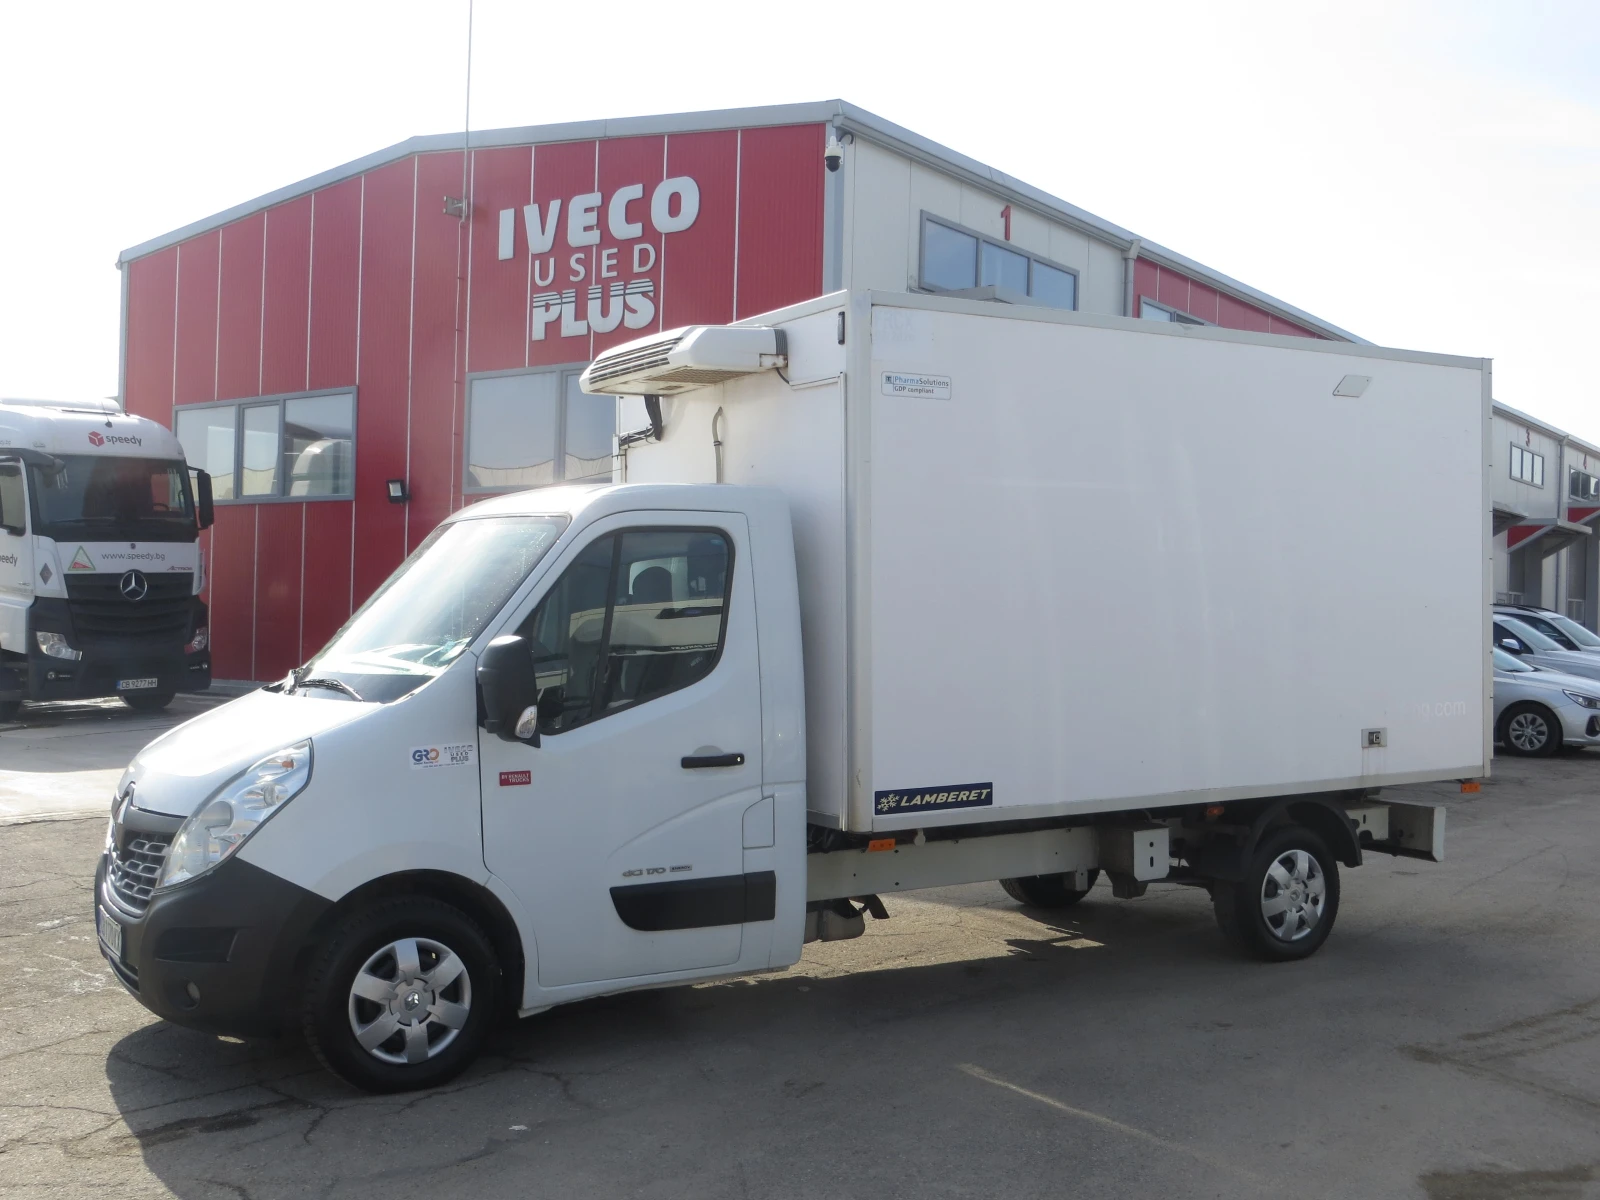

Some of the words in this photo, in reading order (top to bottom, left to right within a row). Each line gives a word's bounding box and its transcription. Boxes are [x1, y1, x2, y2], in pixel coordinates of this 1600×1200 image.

[498, 176, 700, 261] IVECO
[1001, 205, 1011, 241] 1
[534, 243, 656, 286] USED
[531, 278, 655, 341] PLUS
[894, 376, 949, 387] PharmaSolutions
[105, 434, 142, 447] speedy
[101, 552, 166, 562] www.speedy.bg
[412, 748, 440, 763] GRO
[900, 788, 991, 807] LAMBERET
